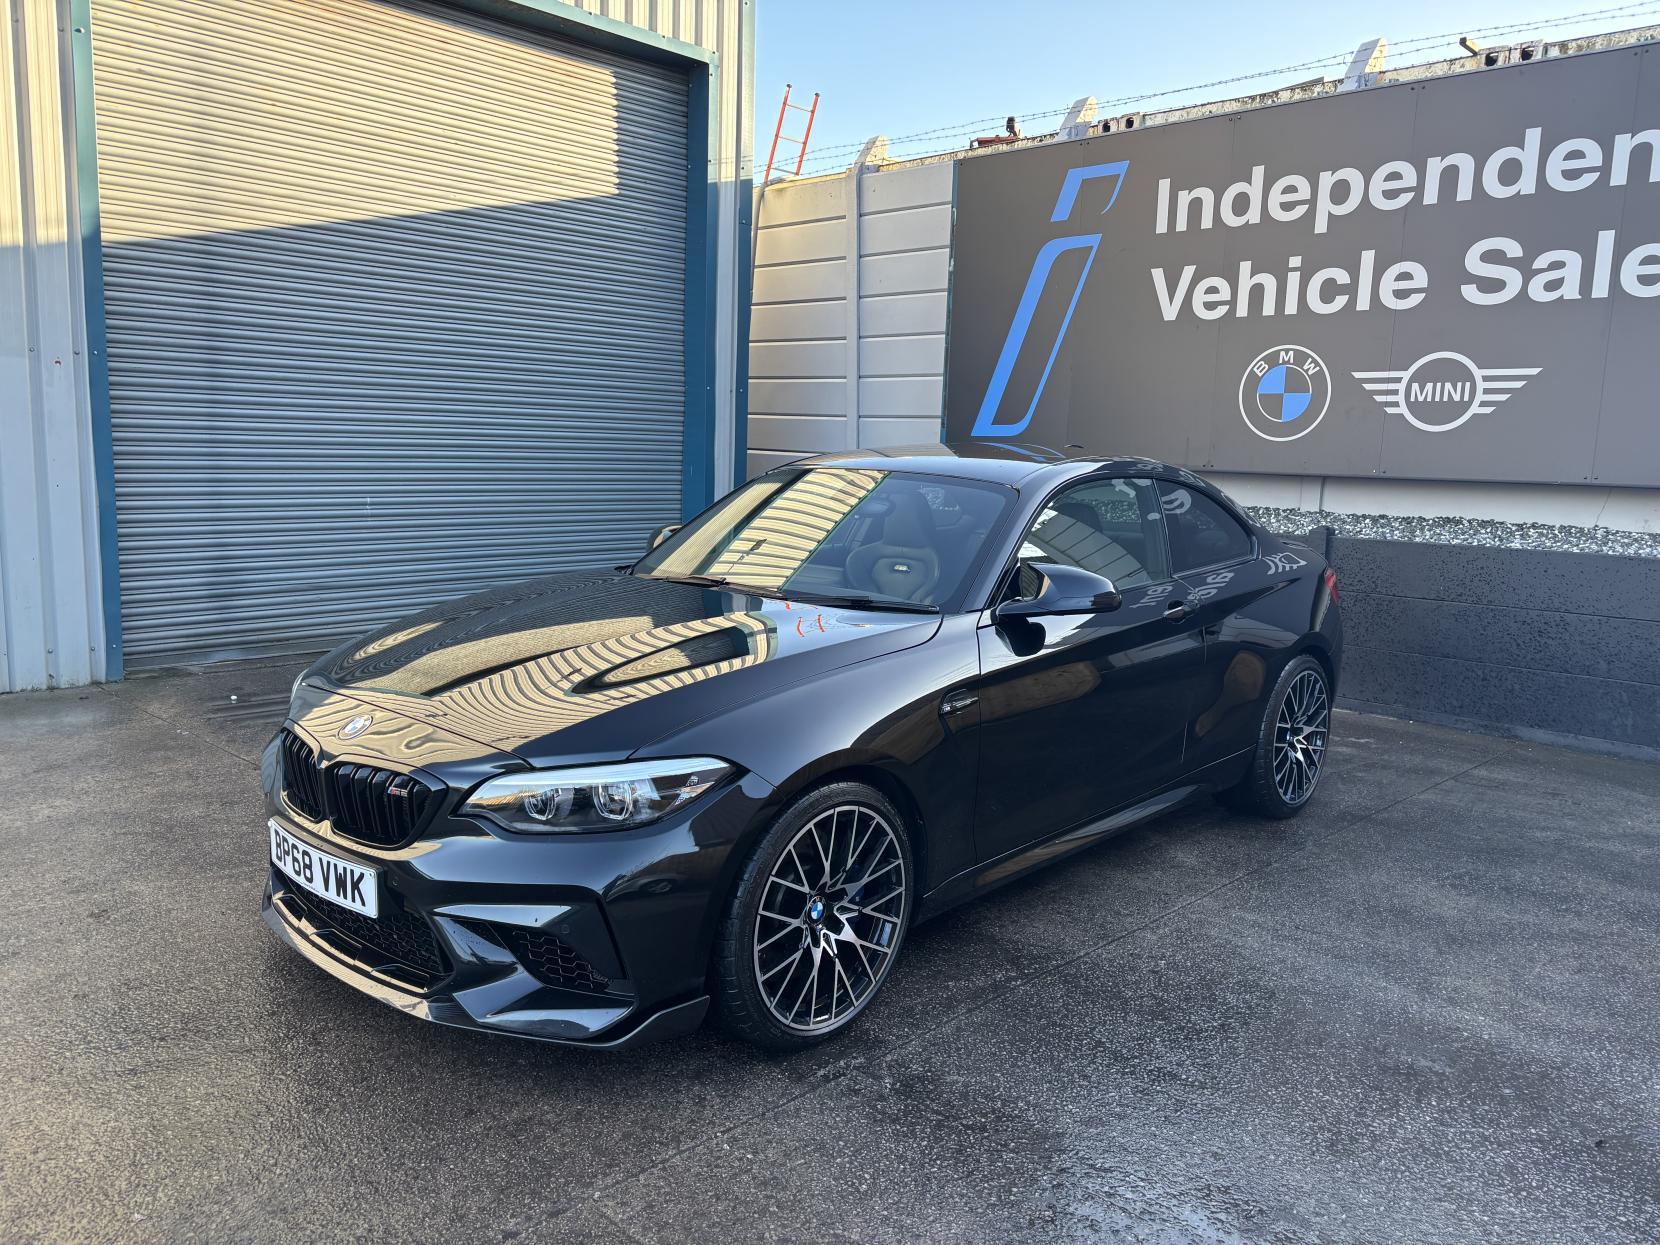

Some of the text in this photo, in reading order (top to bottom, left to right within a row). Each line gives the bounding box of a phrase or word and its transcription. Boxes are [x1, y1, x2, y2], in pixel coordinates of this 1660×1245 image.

[1156, 127, 1660, 234] Independen
[1151, 230, 1660, 321] Vehicle Sale
[1253, 350, 1320, 377] BMW
[1410, 381, 1471, 402] MINI
[274, 828, 366, 907] BP68 VWK
